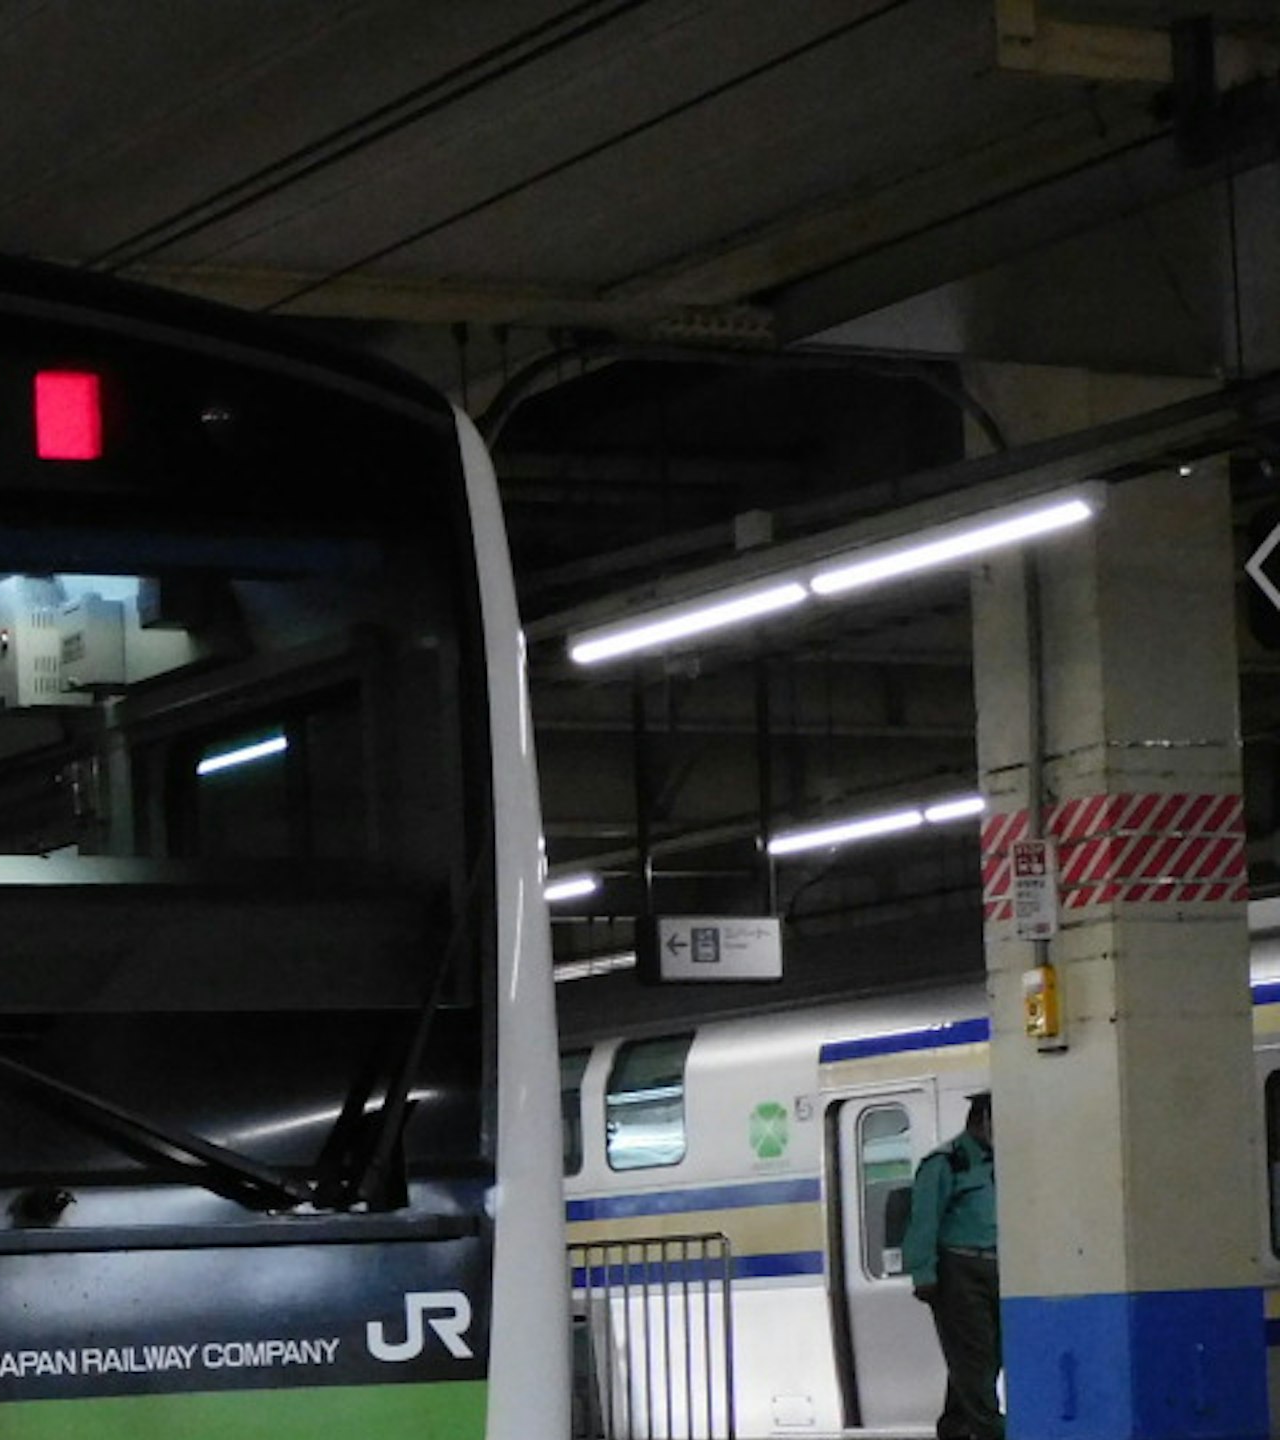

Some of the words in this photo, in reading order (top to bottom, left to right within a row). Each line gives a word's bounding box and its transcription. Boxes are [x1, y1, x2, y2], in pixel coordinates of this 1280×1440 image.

[366, 1288, 474, 1363] JR
[81, 1342, 199, 1374] RAILWAY
[202, 1337, 340, 1368] COMPANY
